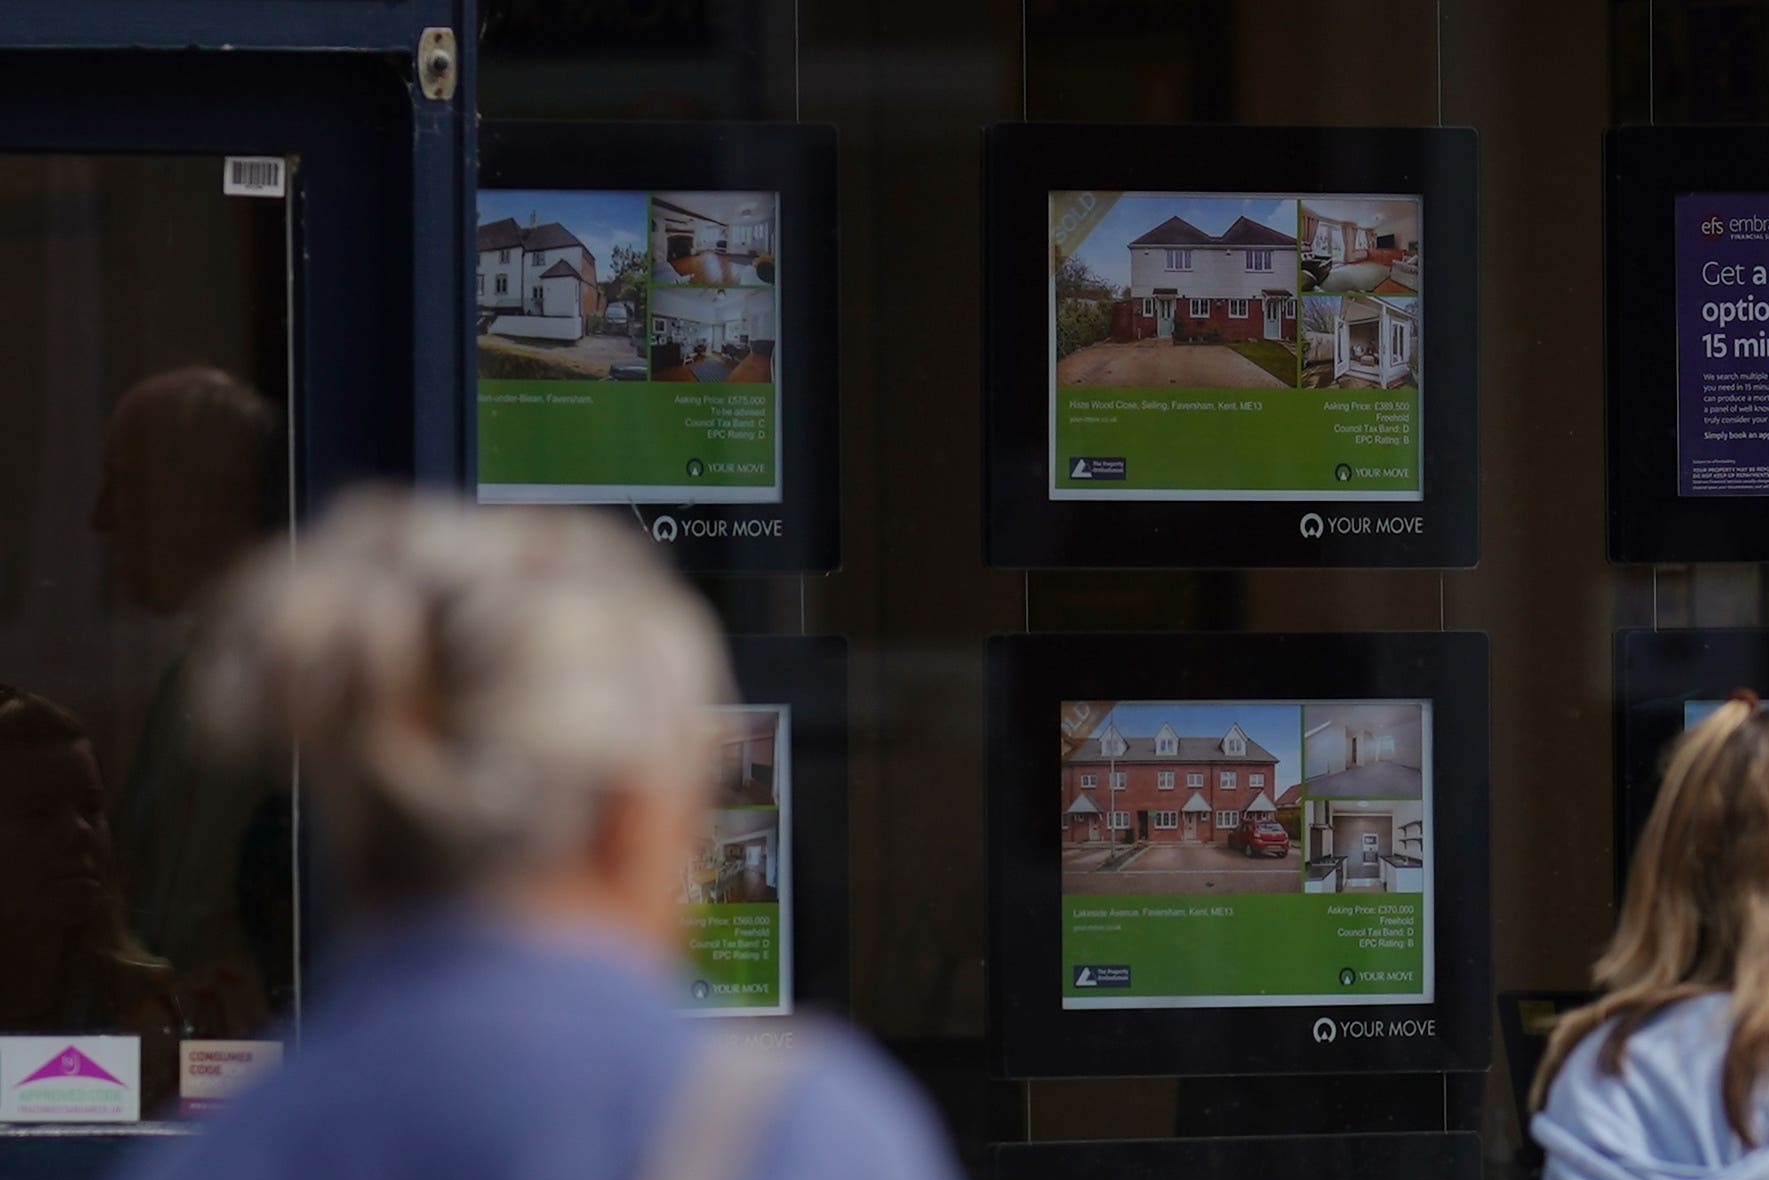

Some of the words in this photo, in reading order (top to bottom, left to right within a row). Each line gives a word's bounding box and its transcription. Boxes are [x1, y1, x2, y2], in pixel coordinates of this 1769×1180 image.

[1701, 216, 1723, 234] efs
[1702, 261, 1744, 285] Get
[1752, 264, 1766, 285] a
[1701, 333, 1726, 358] 15
[1716, 373, 1738, 381] search
[1740, 373, 1768, 382] multiple
[1703, 385, 1716, 393] you
[1717, 394, 1745, 403] produce
[1709, 405, 1729, 414] panel
[1376, 414, 1409, 422] Freehold
[1703, 416, 1720, 424] truly
[1721, 416, 1750, 424] consider
[1752, 417, 1767, 425] your
[1334, 424, 1362, 433] Council
[1364, 424, 1377, 433] Tax
[1703, 431, 1728, 441] Simply
[1728, 431, 1747, 440] book
[708, 463, 735, 473] YOUR
[737, 463, 766, 473] MOVE
[1355, 468, 1382, 478] YOUR
[1383, 468, 1409, 478] MOVE
[682, 519, 728, 537] YOUR
[732, 519, 783, 537] MOVE
[1328, 516, 1371, 534] YOUR
[1376, 516, 1424, 534] MOVE
[1327, 905, 1353, 915] Asking
[1379, 916, 1414, 925] Freehold
[1337, 928, 1366, 937] Council
[1368, 928, 1381, 937] Tax
[1359, 972, 1385, 981] YOUR
[1386, 972, 1414, 981] MOVE
[1340, 1020, 1384, 1038] YOUR
[1388, 1020, 1436, 1038] MOVE
